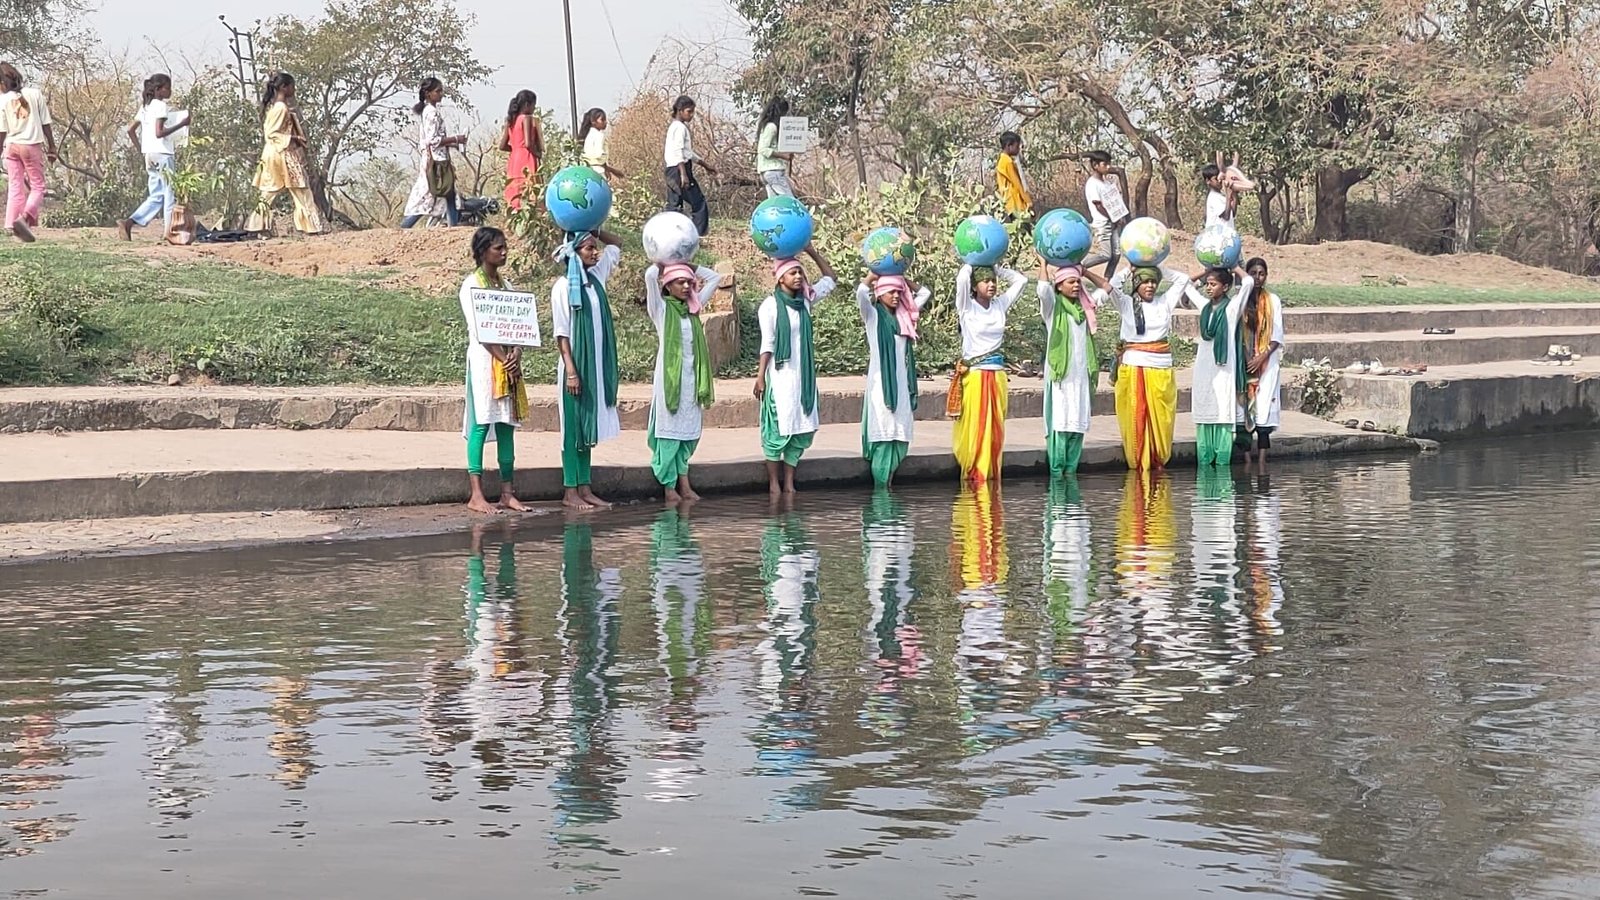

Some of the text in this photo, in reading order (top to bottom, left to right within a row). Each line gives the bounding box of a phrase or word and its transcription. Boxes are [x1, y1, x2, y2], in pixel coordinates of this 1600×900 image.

[476, 303, 531, 317] HAPPY EARTH DAY
[498, 330, 537, 340] SAVE EARTH
